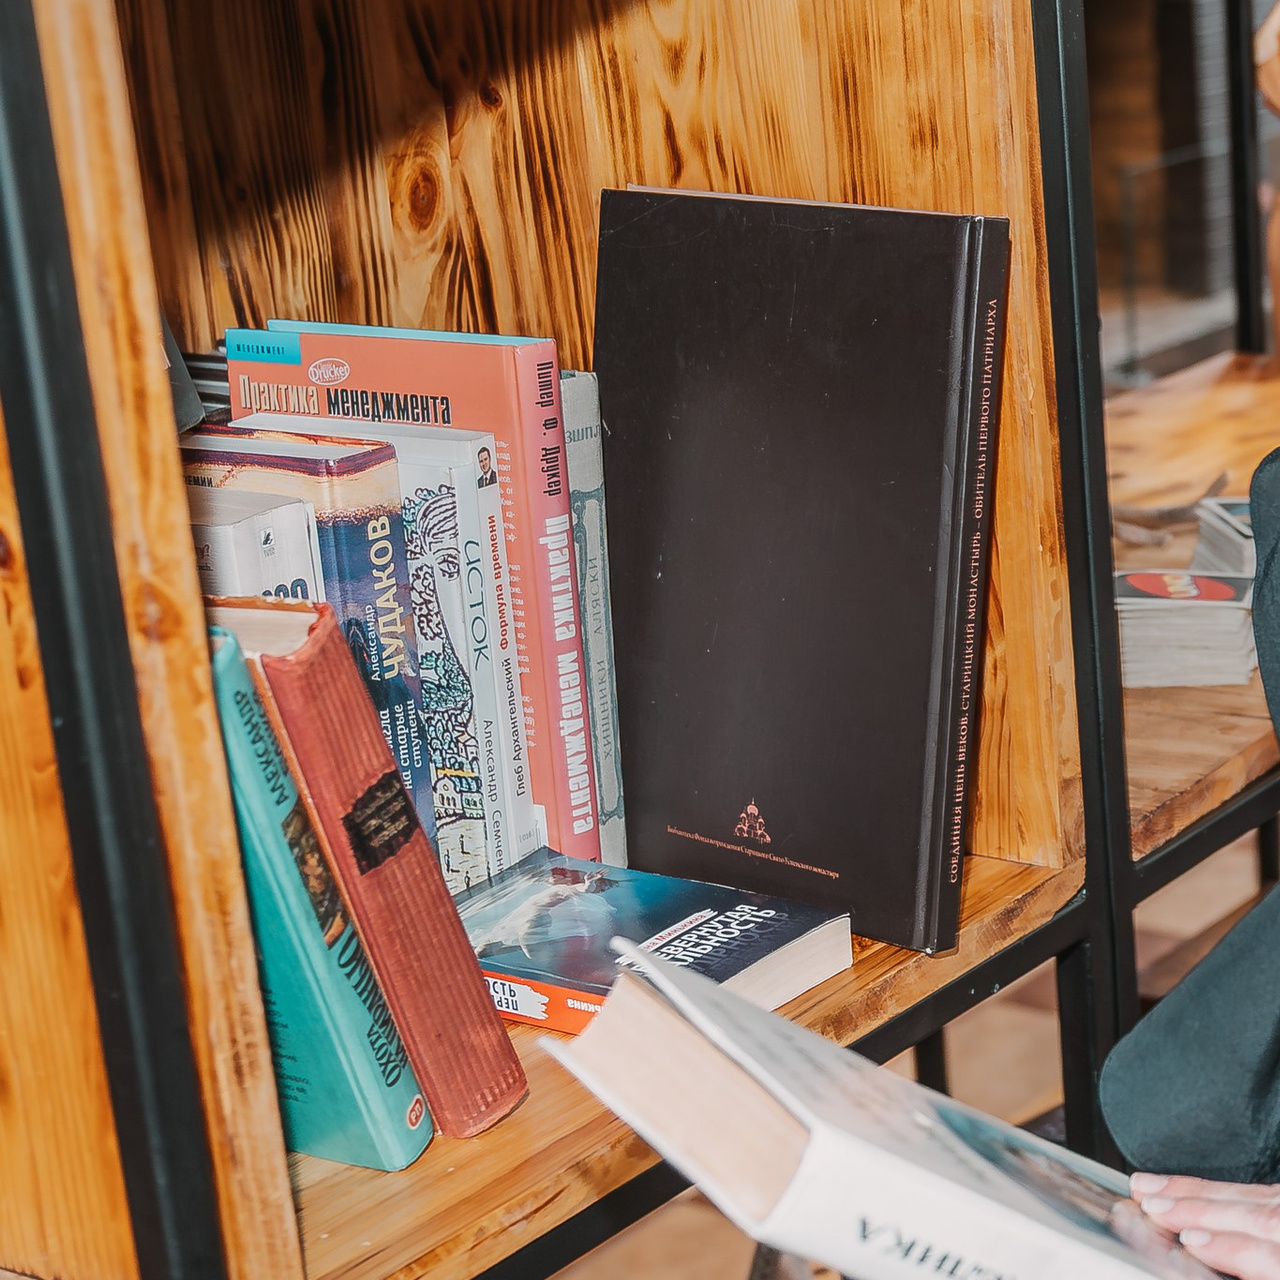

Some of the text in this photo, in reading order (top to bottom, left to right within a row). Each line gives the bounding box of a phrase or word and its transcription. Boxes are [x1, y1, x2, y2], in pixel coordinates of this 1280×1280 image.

[983, 298, 998, 384] ПАТРИАРХА
[239, 375, 451, 425] Практика менеджмента
[535, 361, 554, 408] Питер
[978, 387, 992, 451] ПЕРВОГО
[540, 445, 562, 497] Друкер
[974, 454, 988, 519] ОБИТЕЛЬ
[368, 516, 399, 680] ЧУДАКОВ
[488, 514, 509, 650] Формула времени
[587, 556, 604, 636] АЛЯСКИ
[967, 531, 983, 620] МОНАСТЫРЬ
[364, 604, 381, 681] Александр
[539, 513, 595, 835] Практика менеджмента
[960, 623, 975, 710] СТАРИЦКИЙ
[233, 689, 290, 806] АЛЕКСАНДР
[394, 703, 414, 791] на старые
[406, 699, 423, 768] ступени
[502, 656, 526, 797] Глеб Архангельский
[957, 713, 969, 761] ВЕКОВ.
[483, 719, 504, 872] Александр Семчен
[954, 763, 967, 802] ЦЕПЬ
[950, 804, 963, 883] СОЕДИНЯЯ
[650, 904, 758, 963] ЕВЕРНУТАЯ
[672, 909, 776, 968] ЛЬНОСТЬ
[566, 998, 602, 1013] ькина
[367, 1022, 404, 1088] ОХОТА
